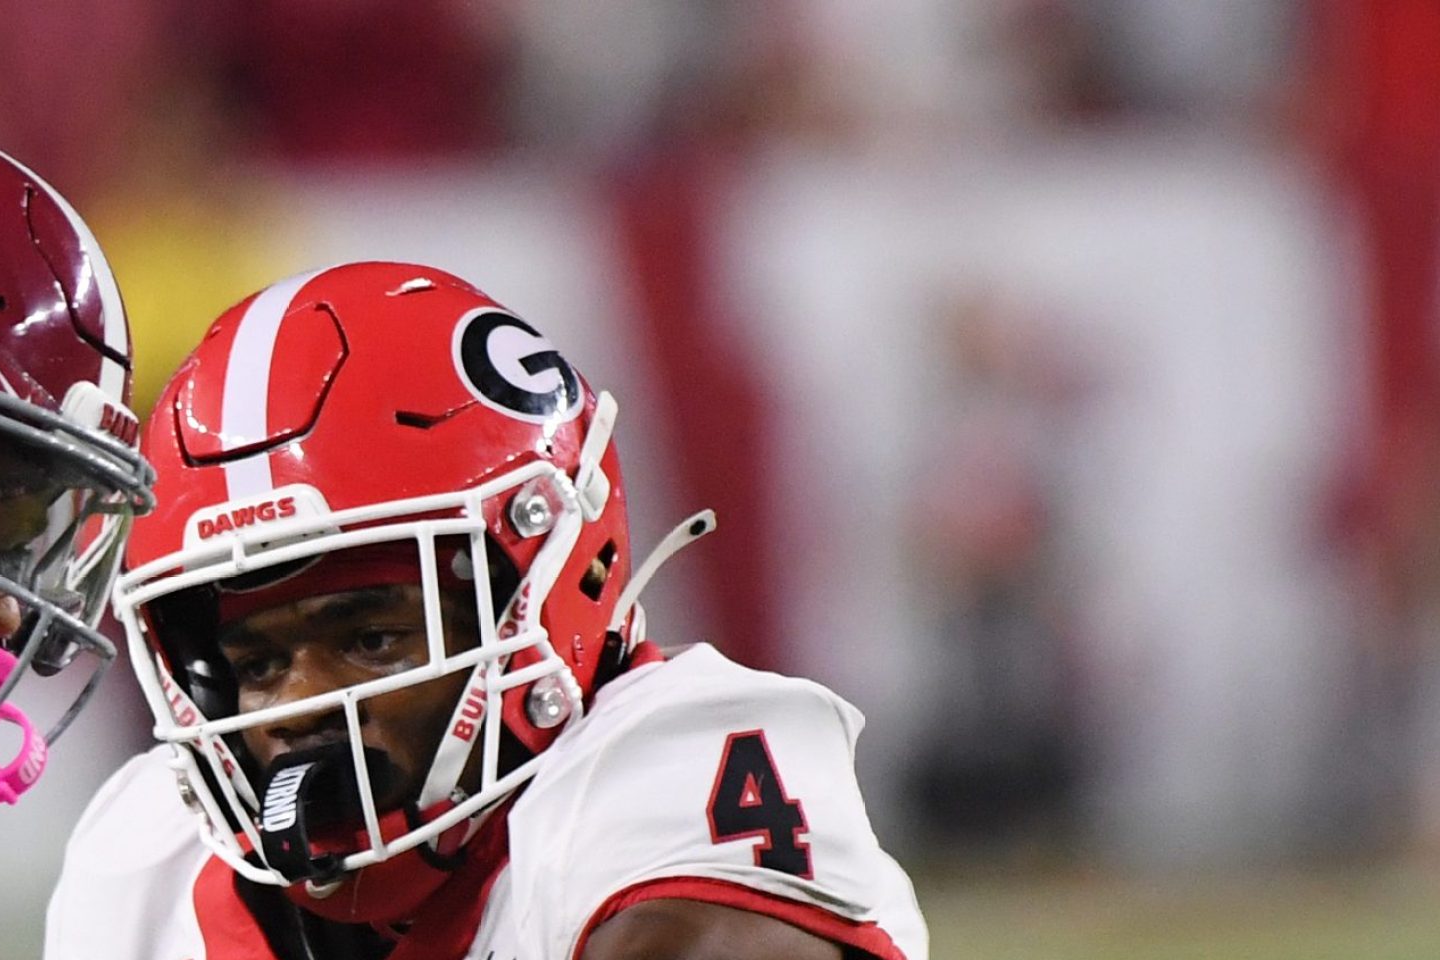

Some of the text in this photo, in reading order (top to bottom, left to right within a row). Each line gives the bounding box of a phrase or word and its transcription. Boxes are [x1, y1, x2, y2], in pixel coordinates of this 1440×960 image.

[453, 307, 586, 424] G
[197, 496, 296, 540] DAWGS
[706, 728, 814, 881] 4
